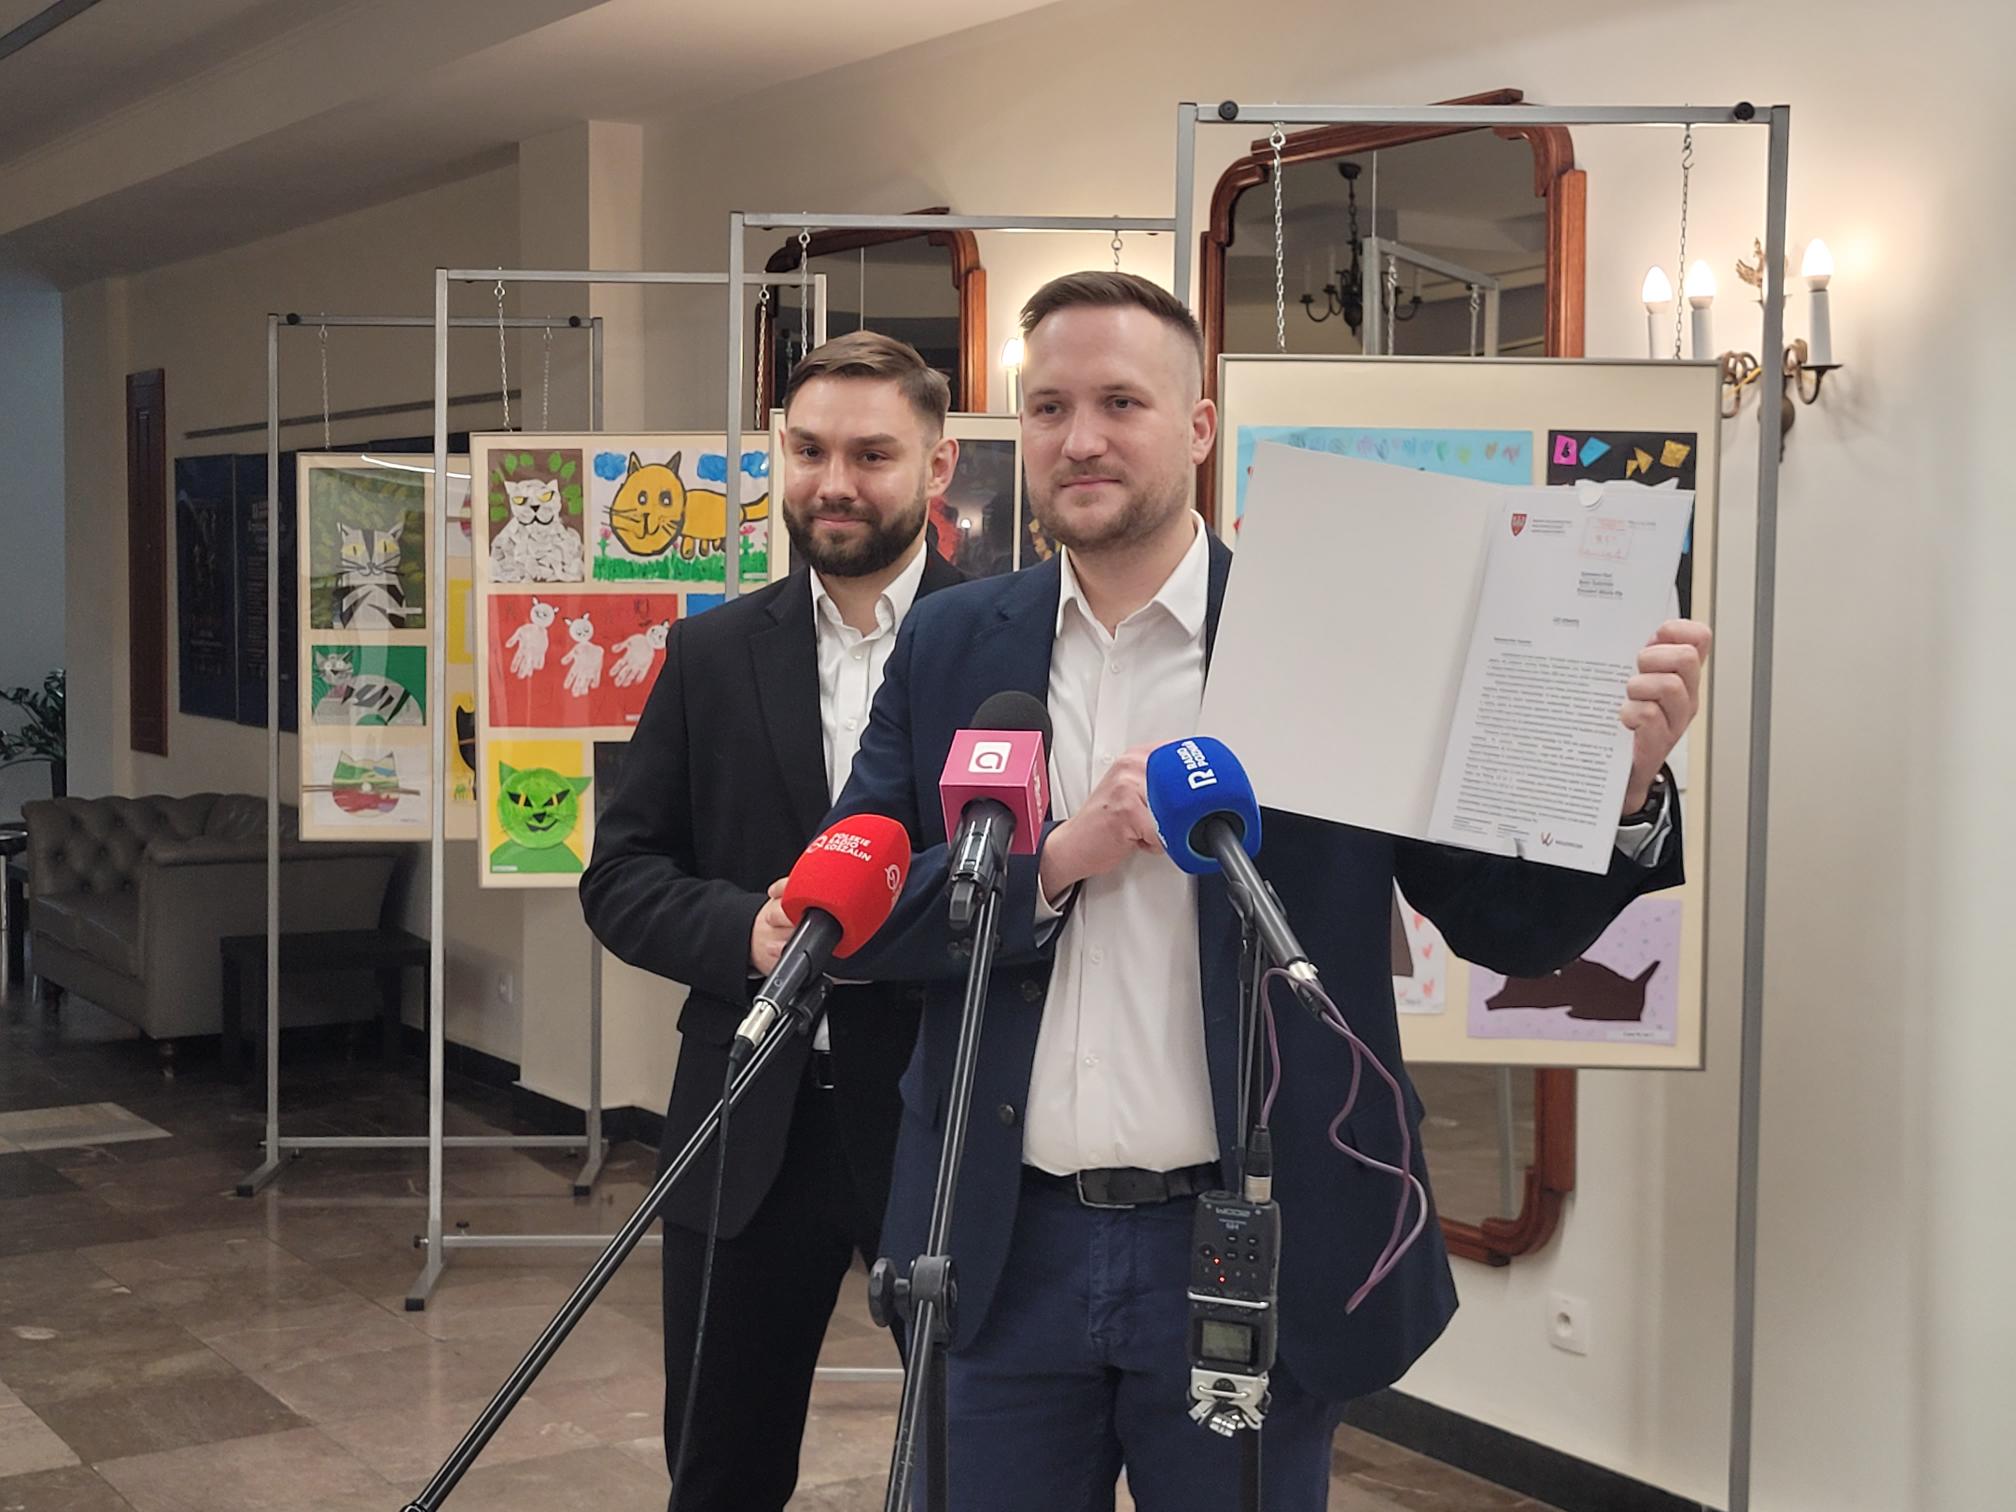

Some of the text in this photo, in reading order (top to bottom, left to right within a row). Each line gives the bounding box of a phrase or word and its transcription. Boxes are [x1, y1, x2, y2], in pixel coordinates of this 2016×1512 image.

[1177, 747, 1197, 770] RADIO
[1187, 768, 1218, 790] R
[824, 844, 873, 862] KOSZALIN
